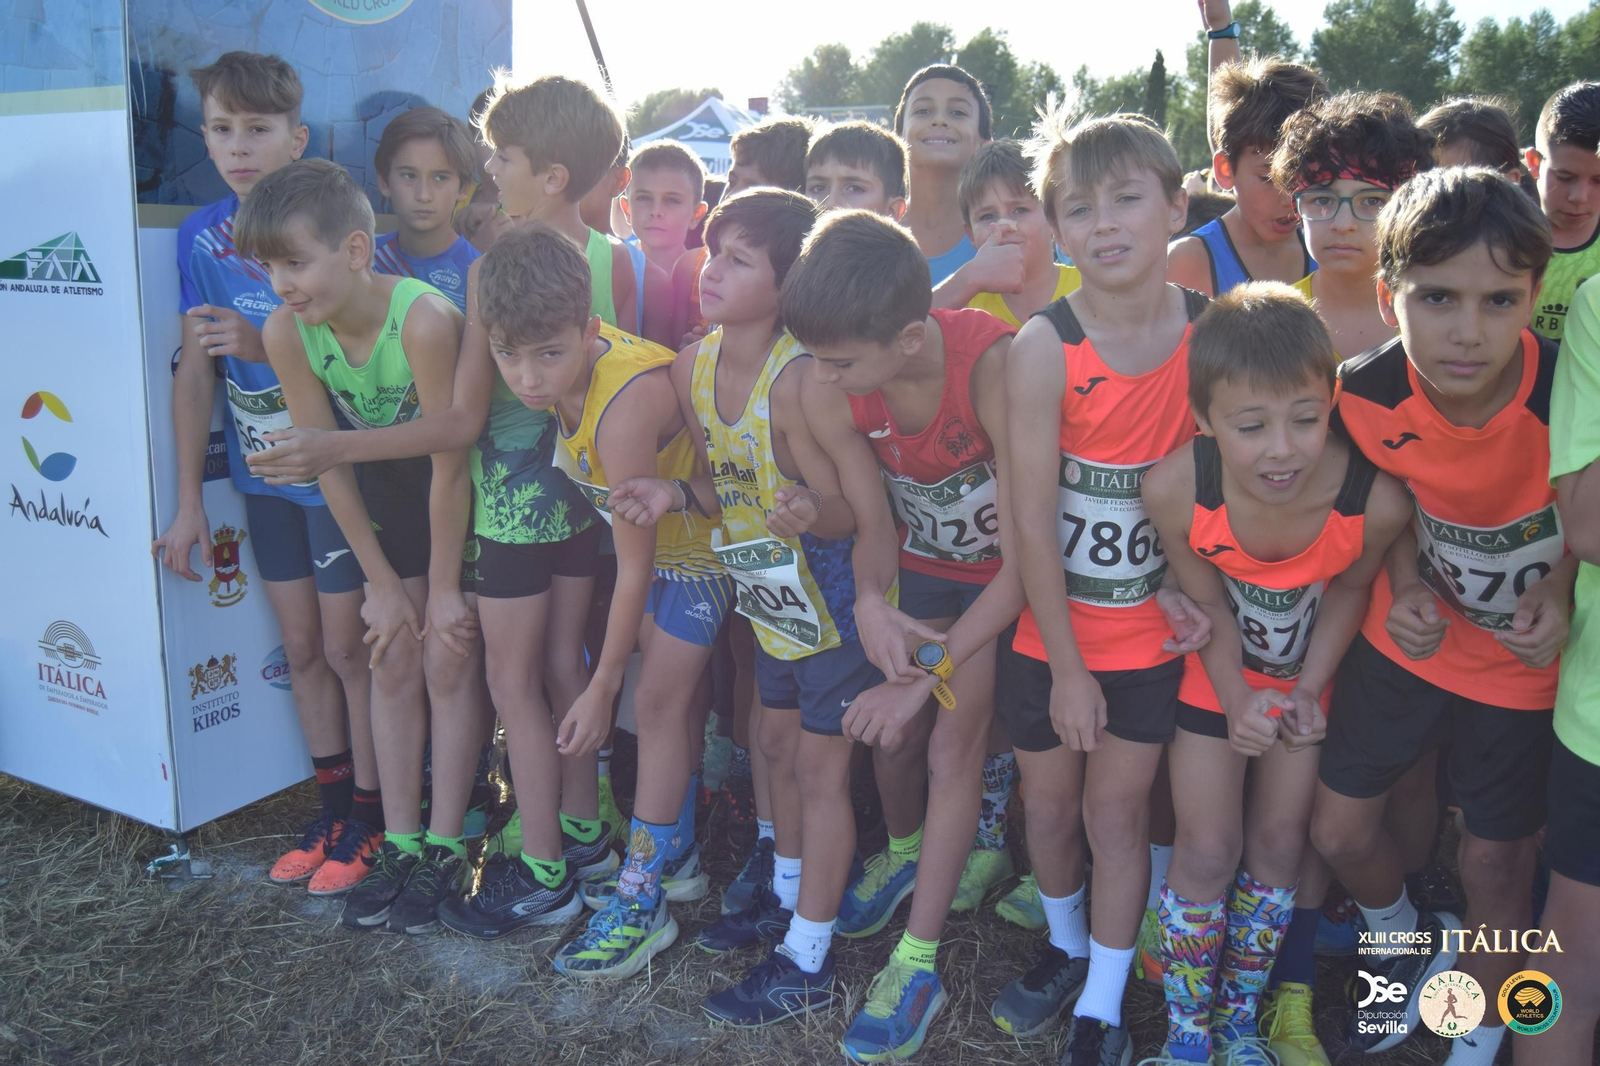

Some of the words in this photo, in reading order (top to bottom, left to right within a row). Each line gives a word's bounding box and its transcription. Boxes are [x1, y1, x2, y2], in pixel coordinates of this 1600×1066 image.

[10, 283, 49, 294] ANDALUZA
[51, 286, 60, 294] DE
[63, 286, 104, 296] ATLETISMO
[9, 483, 110, 538] Andalucía
[1085, 496, 1109, 505] JAVIER
[37, 662, 108, 700] ITÁLICA
[192, 691, 240, 715] INSTITUTO
[193, 702, 241, 733] KIROS
